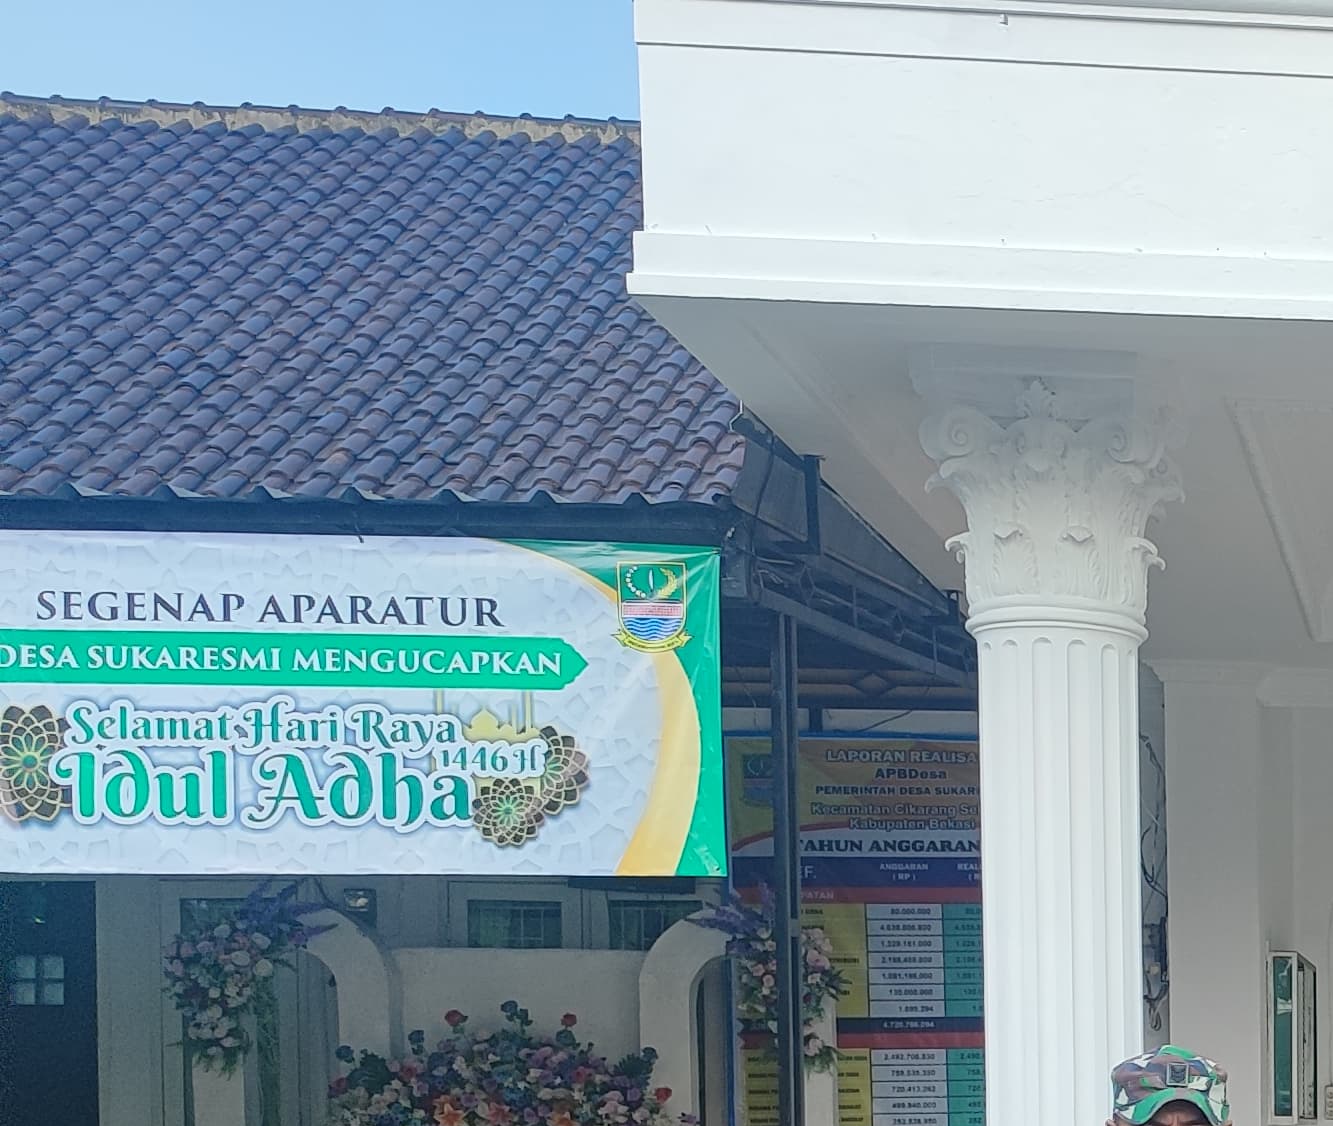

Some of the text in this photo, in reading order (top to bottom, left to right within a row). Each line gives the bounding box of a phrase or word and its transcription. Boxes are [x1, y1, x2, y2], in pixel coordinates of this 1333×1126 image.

[36, 590, 506, 628] SEGENAP APARATUR
[0, 644, 562, 676] DESA SUKARESMI MENGUCAPKAN
[71, 701, 456, 751] Selamat Hari Raya
[440, 745, 541, 774] 1446 H
[826, 749, 977, 764] LAPORAN REALISA
[874, 768, 947, 780] APBDesa
[54, 749, 475, 827] Idul Adha
[815, 785, 895, 796] PEMERINTAH
[899, 786, 931, 796] DESA
[811, 802, 890, 815] Kecamatan
[894, 803, 956, 817] Cikarang
[849, 818, 976, 832] Kabupaten Bekasi
[800, 839, 979, 853] AHUN ANGGARAN
